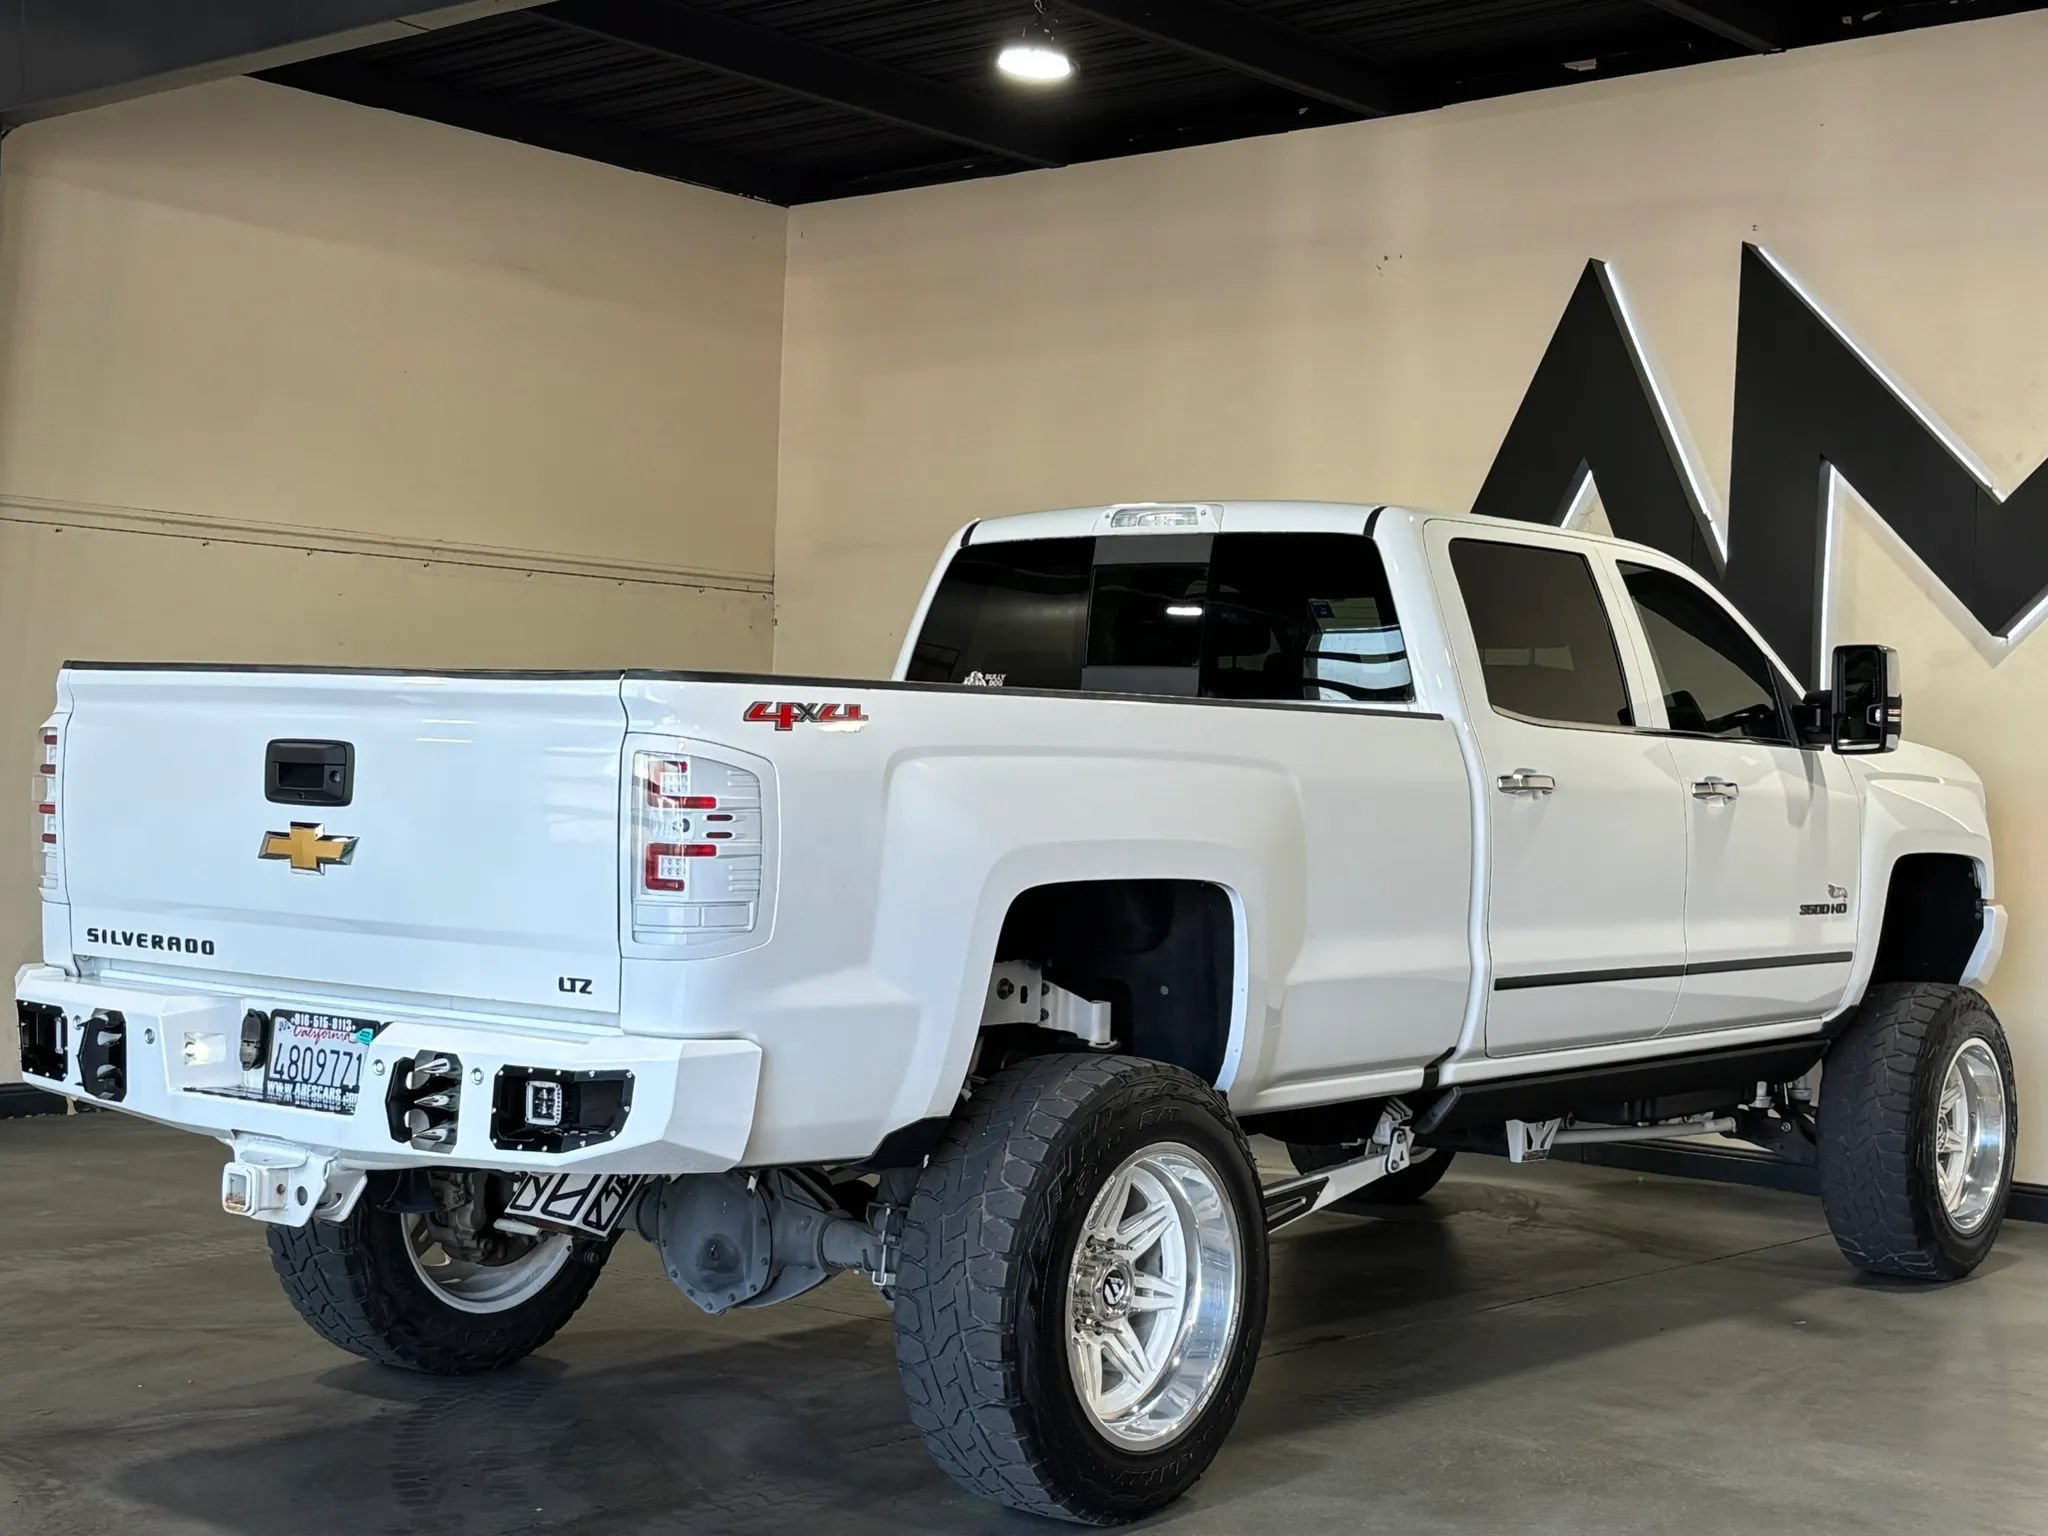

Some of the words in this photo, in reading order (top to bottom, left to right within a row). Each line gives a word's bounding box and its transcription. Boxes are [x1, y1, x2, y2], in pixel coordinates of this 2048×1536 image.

[87, 928, 215, 955] SILVERADO
[559, 976, 592, 994] LTZ
[273, 1042, 362, 1087] 4809771
